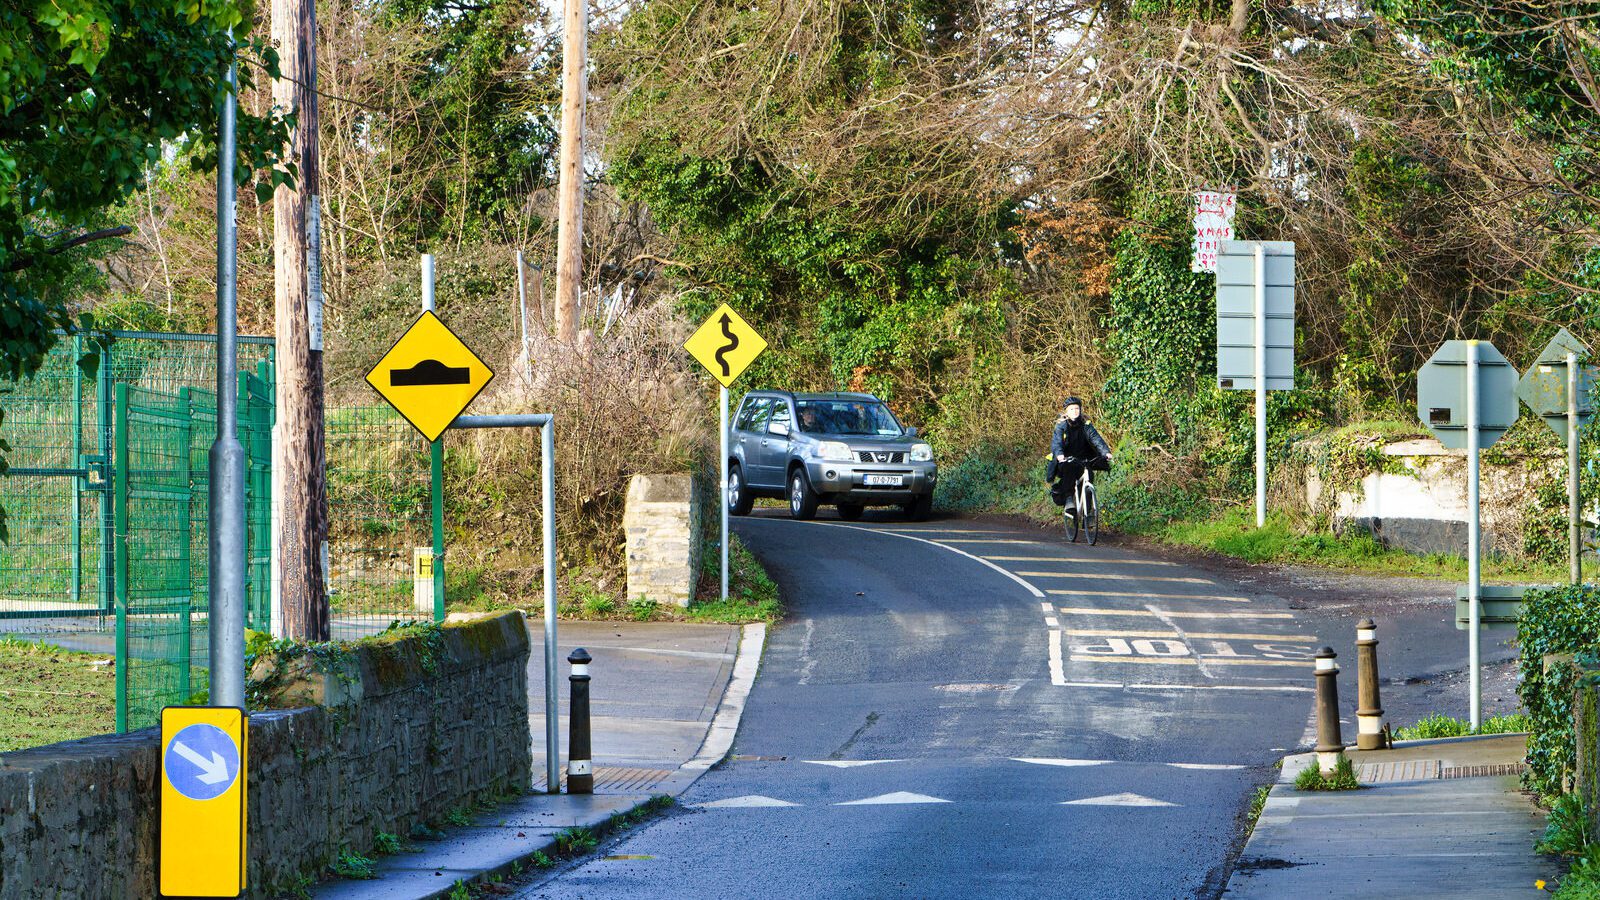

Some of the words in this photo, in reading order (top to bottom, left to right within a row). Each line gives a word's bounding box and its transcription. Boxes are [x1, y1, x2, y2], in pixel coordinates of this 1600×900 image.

[1198, 227, 1230, 238] XMAS
[1199, 241, 1217, 250] TRE
[420, 557, 433, 575] H
[1068, 638, 1316, 660] STOP
